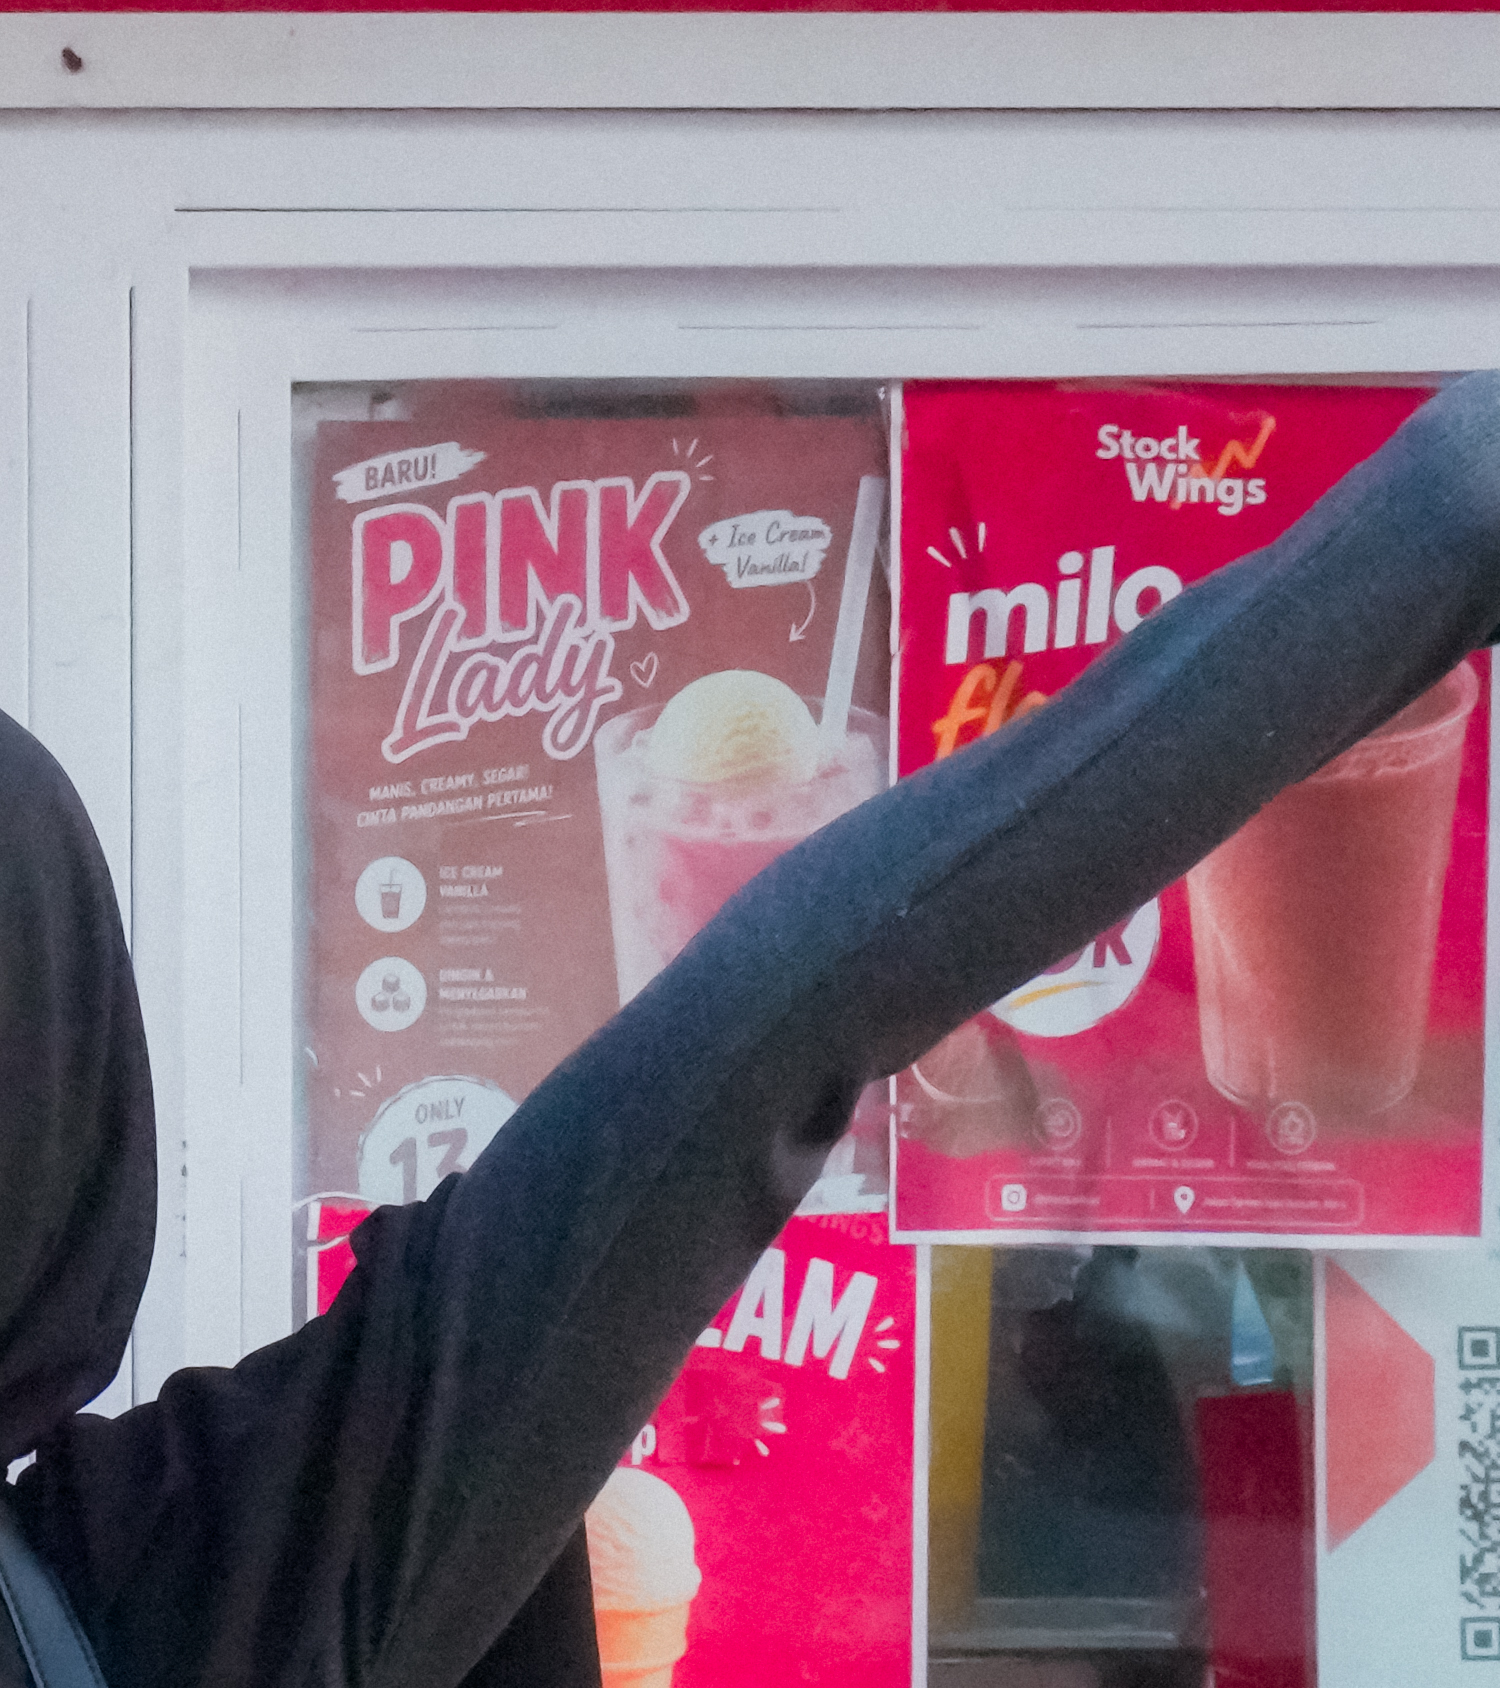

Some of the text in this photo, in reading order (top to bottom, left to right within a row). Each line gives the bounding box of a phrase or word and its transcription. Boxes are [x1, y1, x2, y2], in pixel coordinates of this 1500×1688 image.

[1097, 424, 1200, 461] Stock
[364, 454, 438, 492] BARU!
[1125, 463, 1267, 516] Wings
[728, 523, 758, 547] Ice
[764, 519, 824, 545] Cream
[352, 471, 690, 676] PINK
[736, 554, 807, 579] Vanilla!
[946, 545, 1183, 665] milo
[382, 594, 623, 763] Lady
[357, 785, 553, 827] CINTA PANDANGAN PERTAMA!
[415, 1097, 464, 1124] ONLY
[695, 1247, 878, 1380] AM
